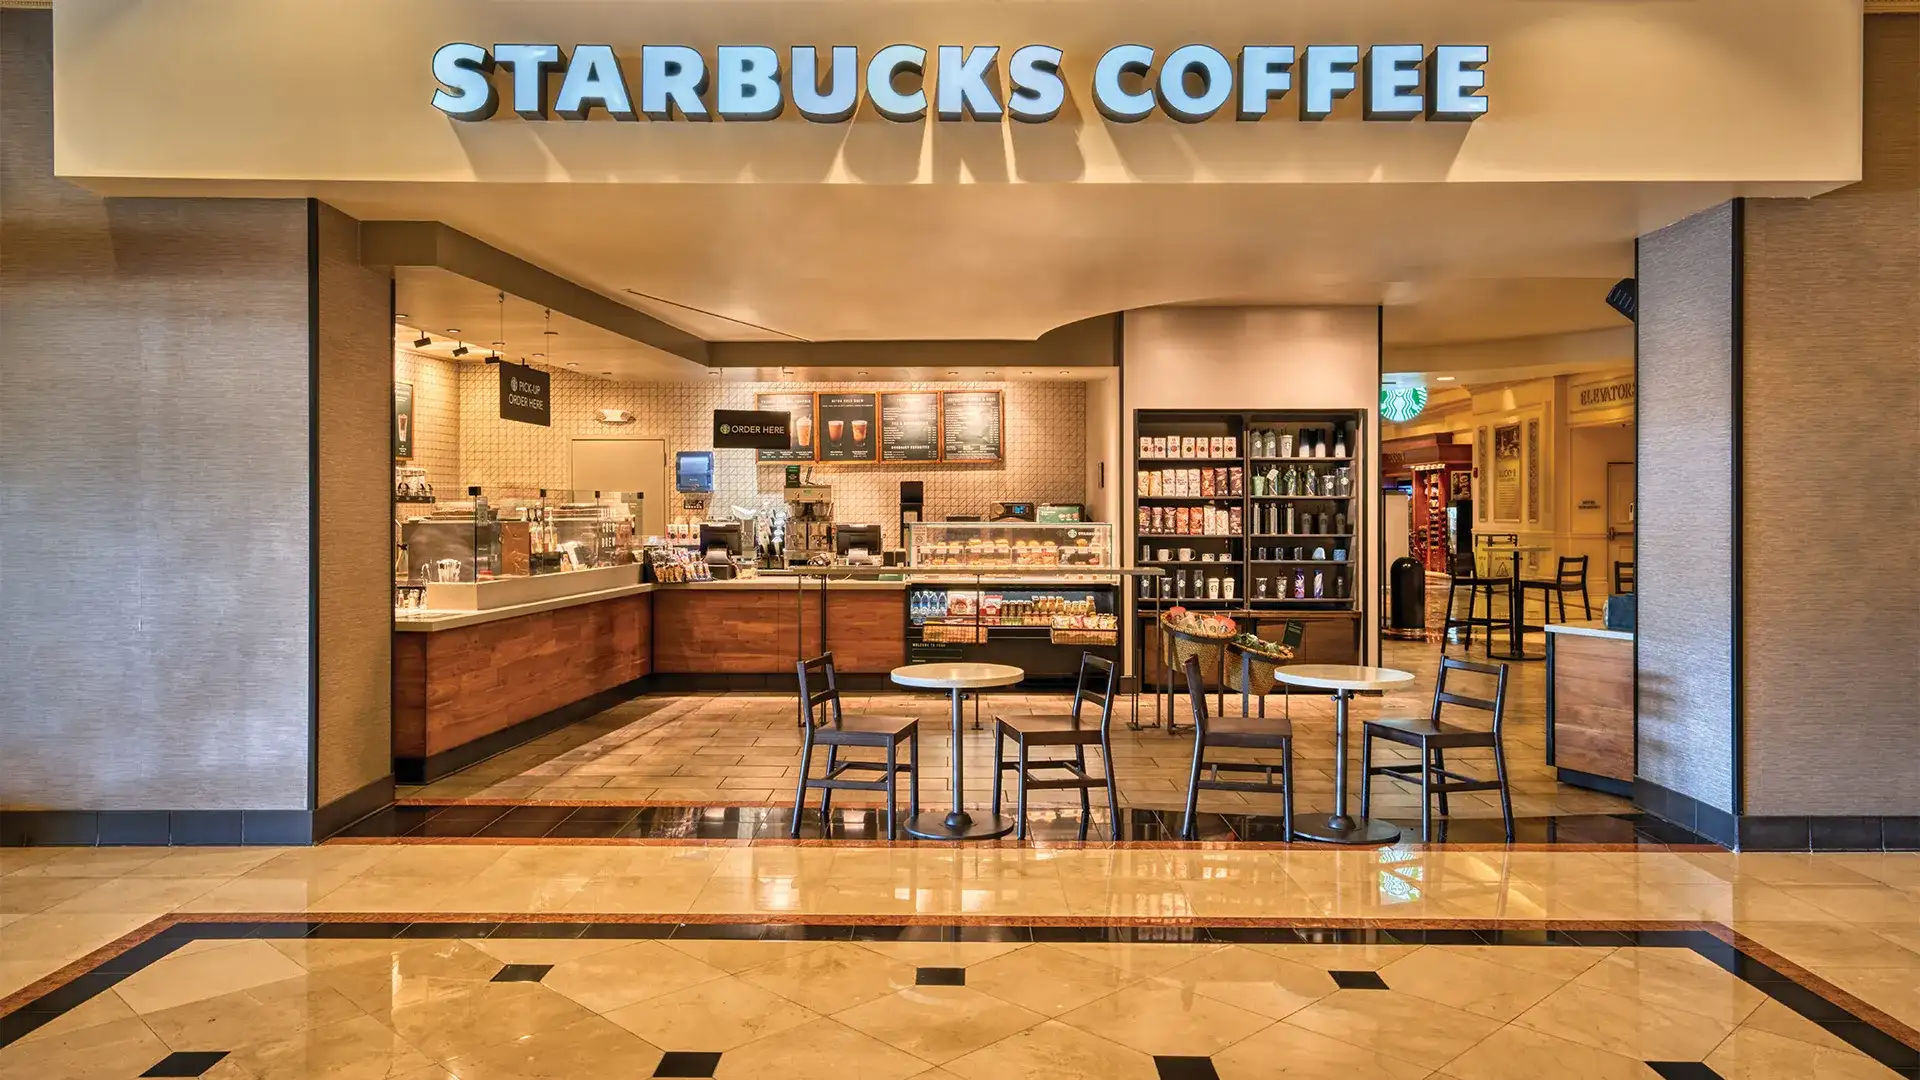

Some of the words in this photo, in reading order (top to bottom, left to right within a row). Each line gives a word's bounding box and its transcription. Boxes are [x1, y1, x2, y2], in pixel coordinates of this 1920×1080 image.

[431, 43, 1066, 121] STARBUCKS
[1092, 44, 1489, 121] COFFEE
[518, 380, 541, 395] PICK-UP
[508, 393, 528, 407] ORDER
[528, 398, 544, 410] HERE
[731, 424, 761, 434] ORDER
[762, 425, 785, 434] HERE
